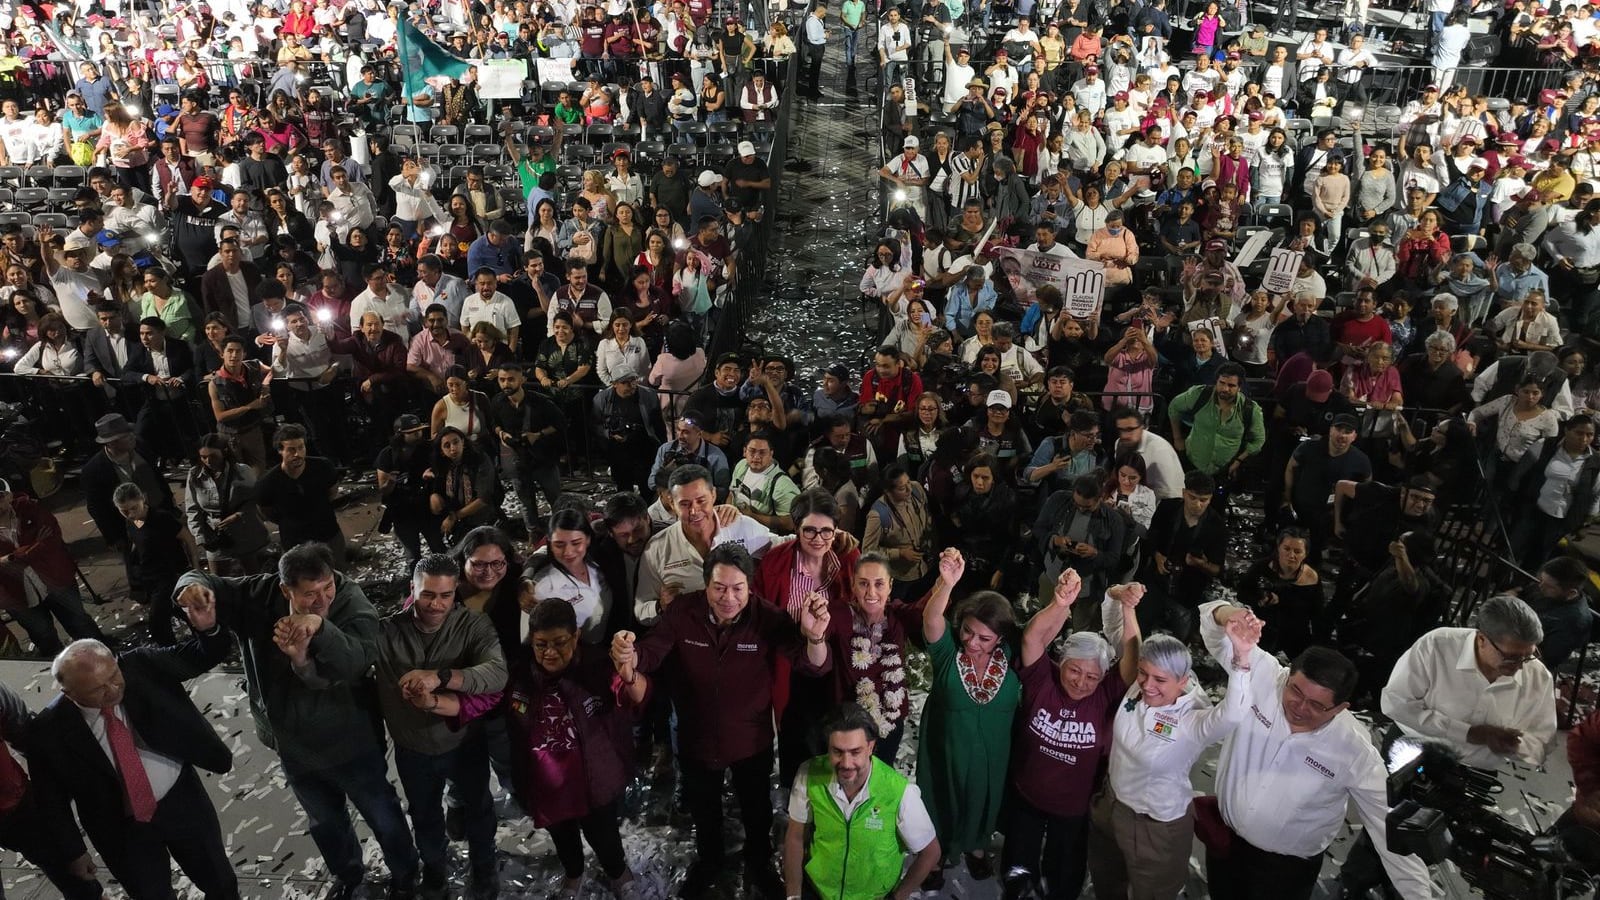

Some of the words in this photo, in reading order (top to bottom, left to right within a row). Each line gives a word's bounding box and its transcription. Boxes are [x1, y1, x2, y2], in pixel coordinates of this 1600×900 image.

[1033, 259, 1061, 272] VOTA
[1037, 708, 1096, 734] CLAUDIA
[1154, 711, 1179, 725] morena
[1032, 716, 1096, 744] SHEINBAUM
[1040, 734, 1081, 750] PRESIDENTA
[1040, 745, 1077, 763] morena
[1304, 755, 1336, 778] morena
